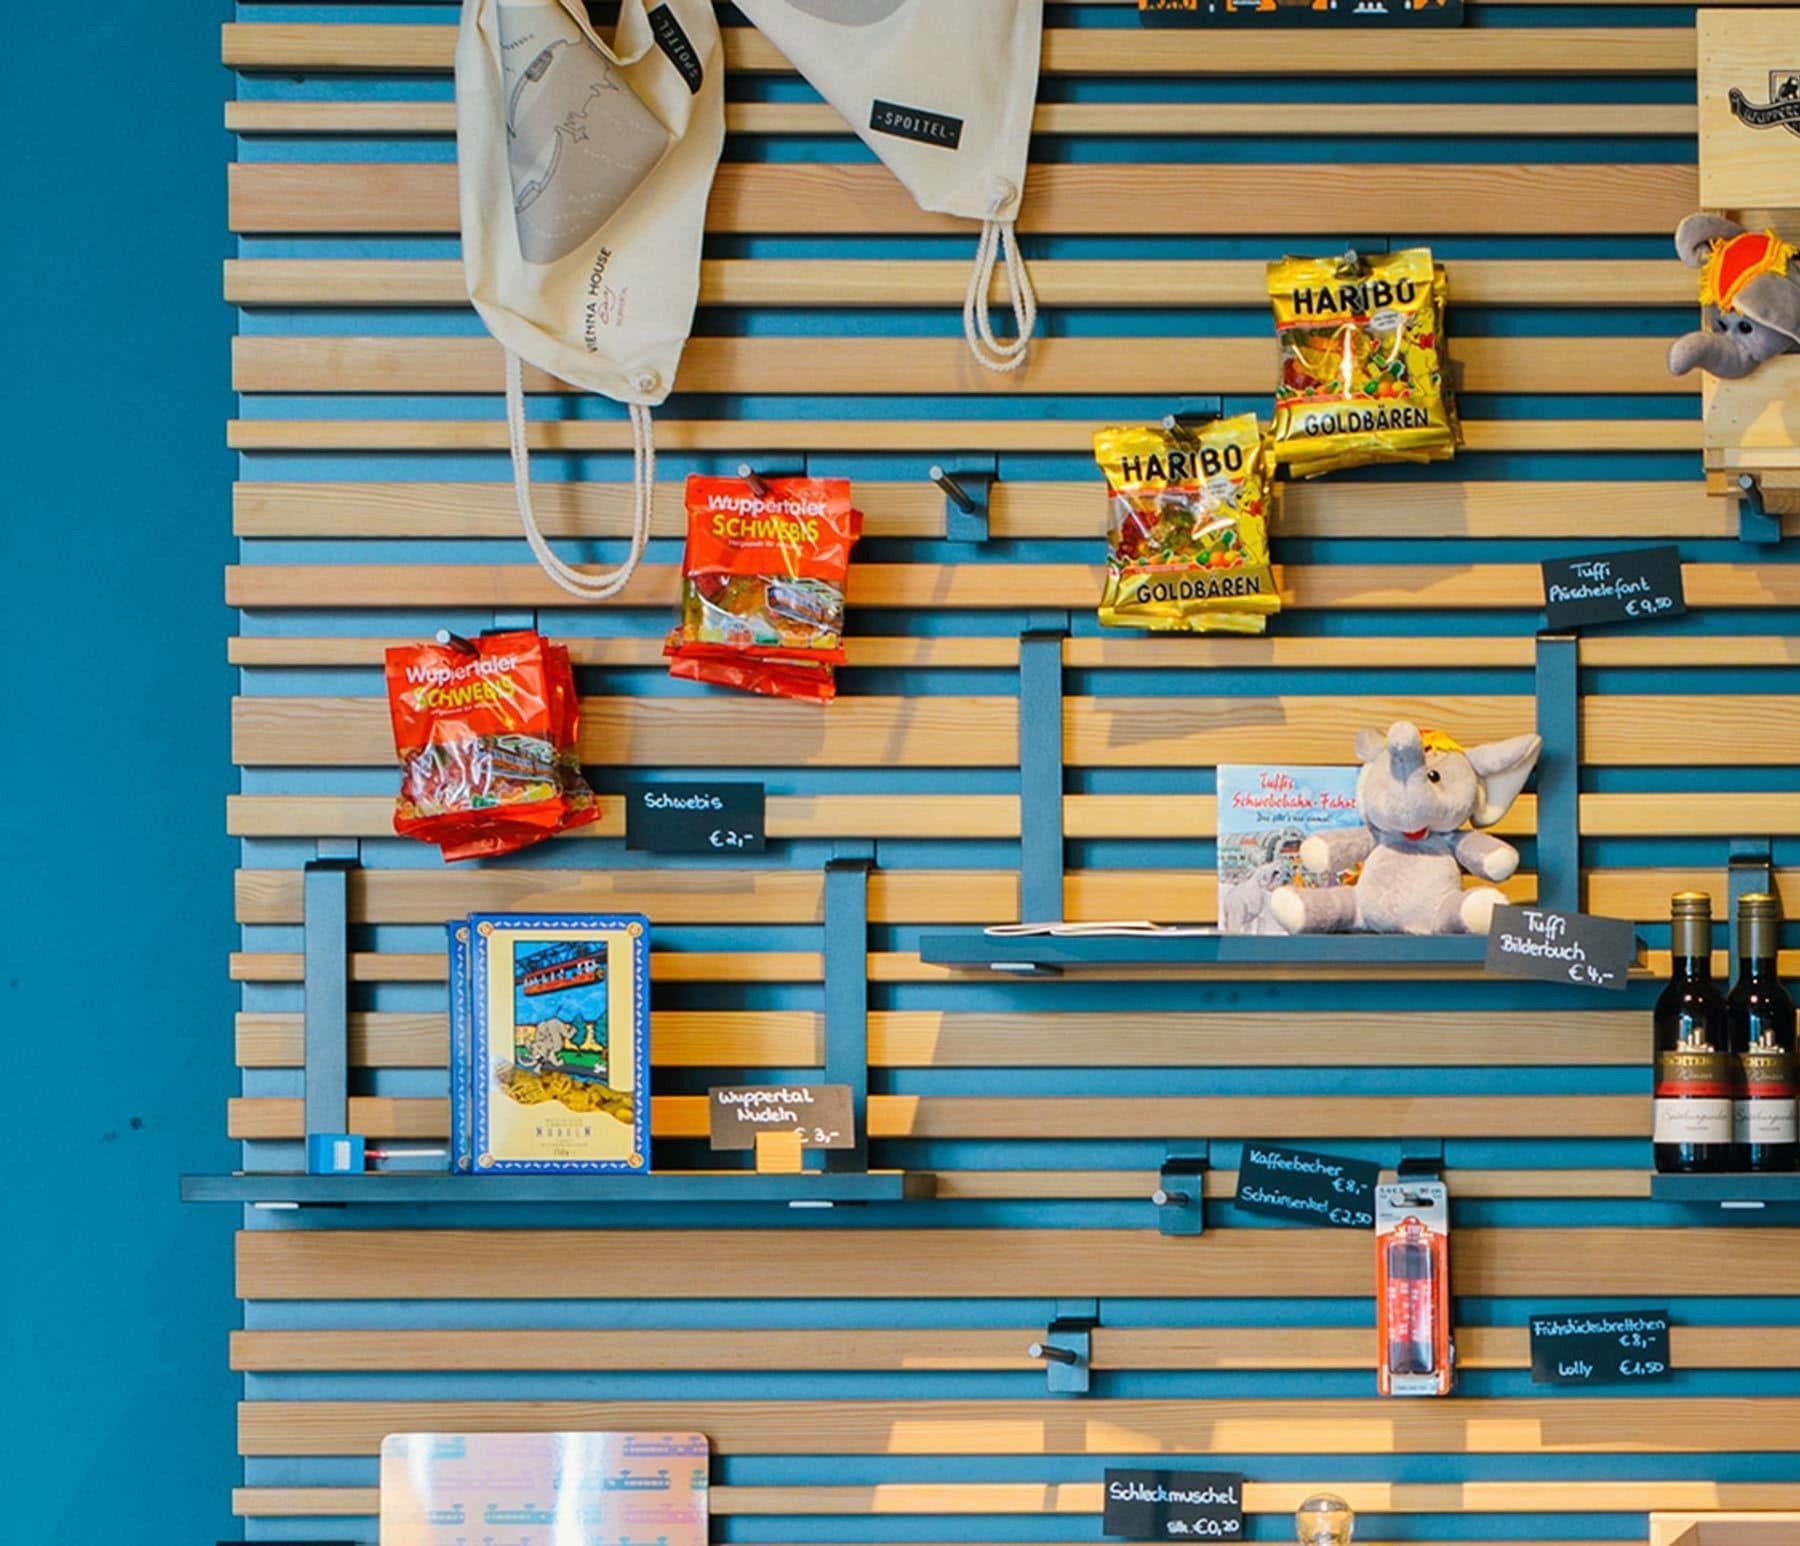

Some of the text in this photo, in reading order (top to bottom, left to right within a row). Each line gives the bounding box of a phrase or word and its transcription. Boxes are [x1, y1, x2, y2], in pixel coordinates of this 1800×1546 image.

[588, 246, 612, 297] HOUSE
[1292, 277, 1416, 315] HARIBO
[1304, 404, 1429, 437] GOLDBÄREN
[1121, 444, 1243, 482] HARIBO
[708, 494, 828, 517] Wuppertaler
[1569, 562, 1611, 581] Tuffi
[1137, 575, 1260, 604] GOLDBÄREN
[644, 792, 723, 810] Schwebis
[1522, 911, 1566, 940] Tuffi
[1500, 934, 1585, 961] Bilderbuch
[718, 1088, 814, 1107] Wuppertal
[737, 1107, 797, 1122] Nudeln
[1250, 1150, 1344, 1176] Kaffeebecher
[1558, 1361, 1593, 1377] Lolly
[1109, 1481, 1238, 1504] Schleckmuschel
